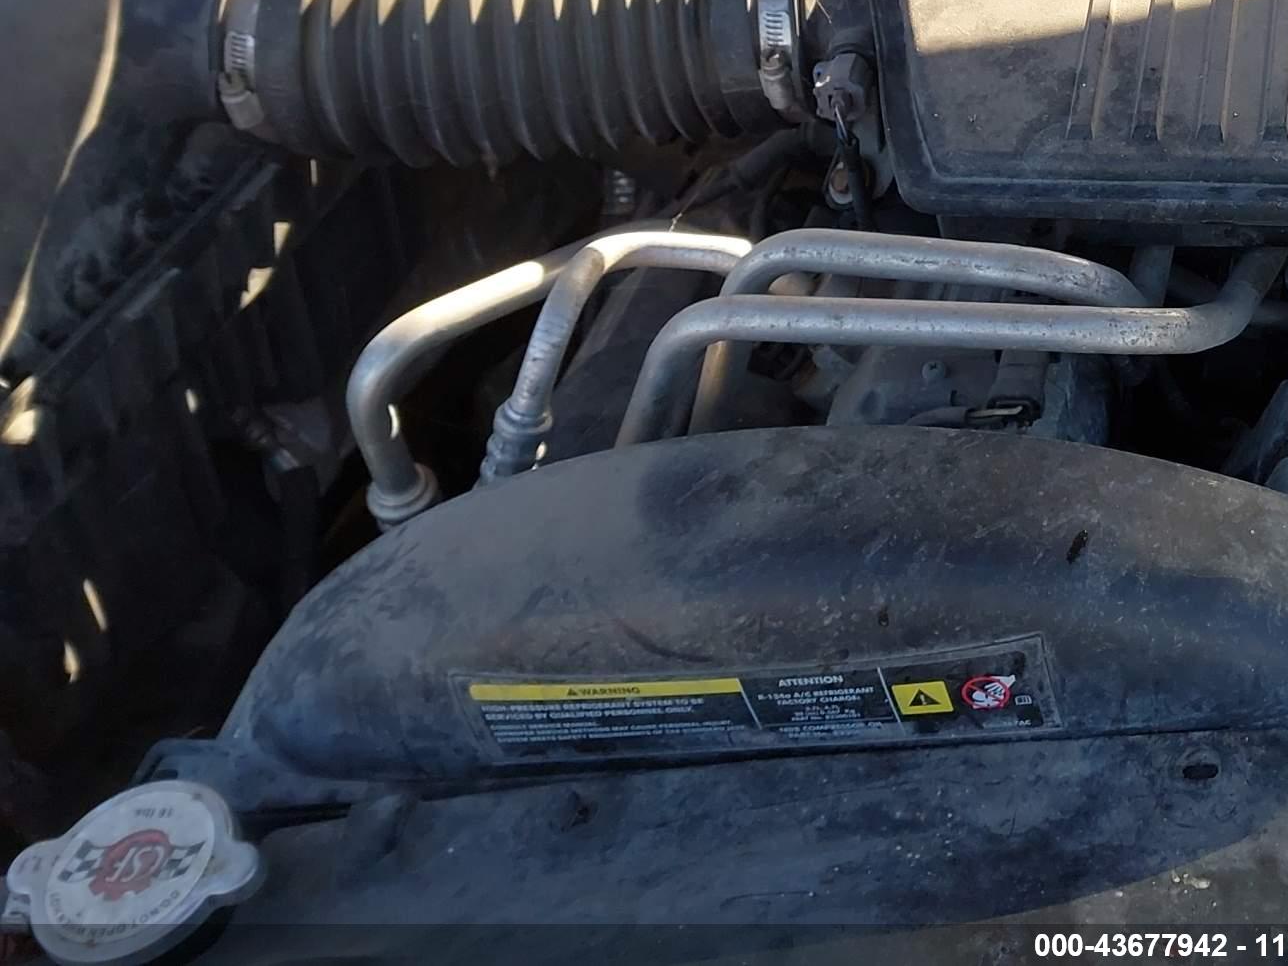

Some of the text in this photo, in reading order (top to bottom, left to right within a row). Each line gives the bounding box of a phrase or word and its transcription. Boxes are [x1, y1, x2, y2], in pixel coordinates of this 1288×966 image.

[778, 675, 843, 687] ATTENTION
[580, 686, 640, 695] WARNING
[104, 844, 164, 882] CSF
